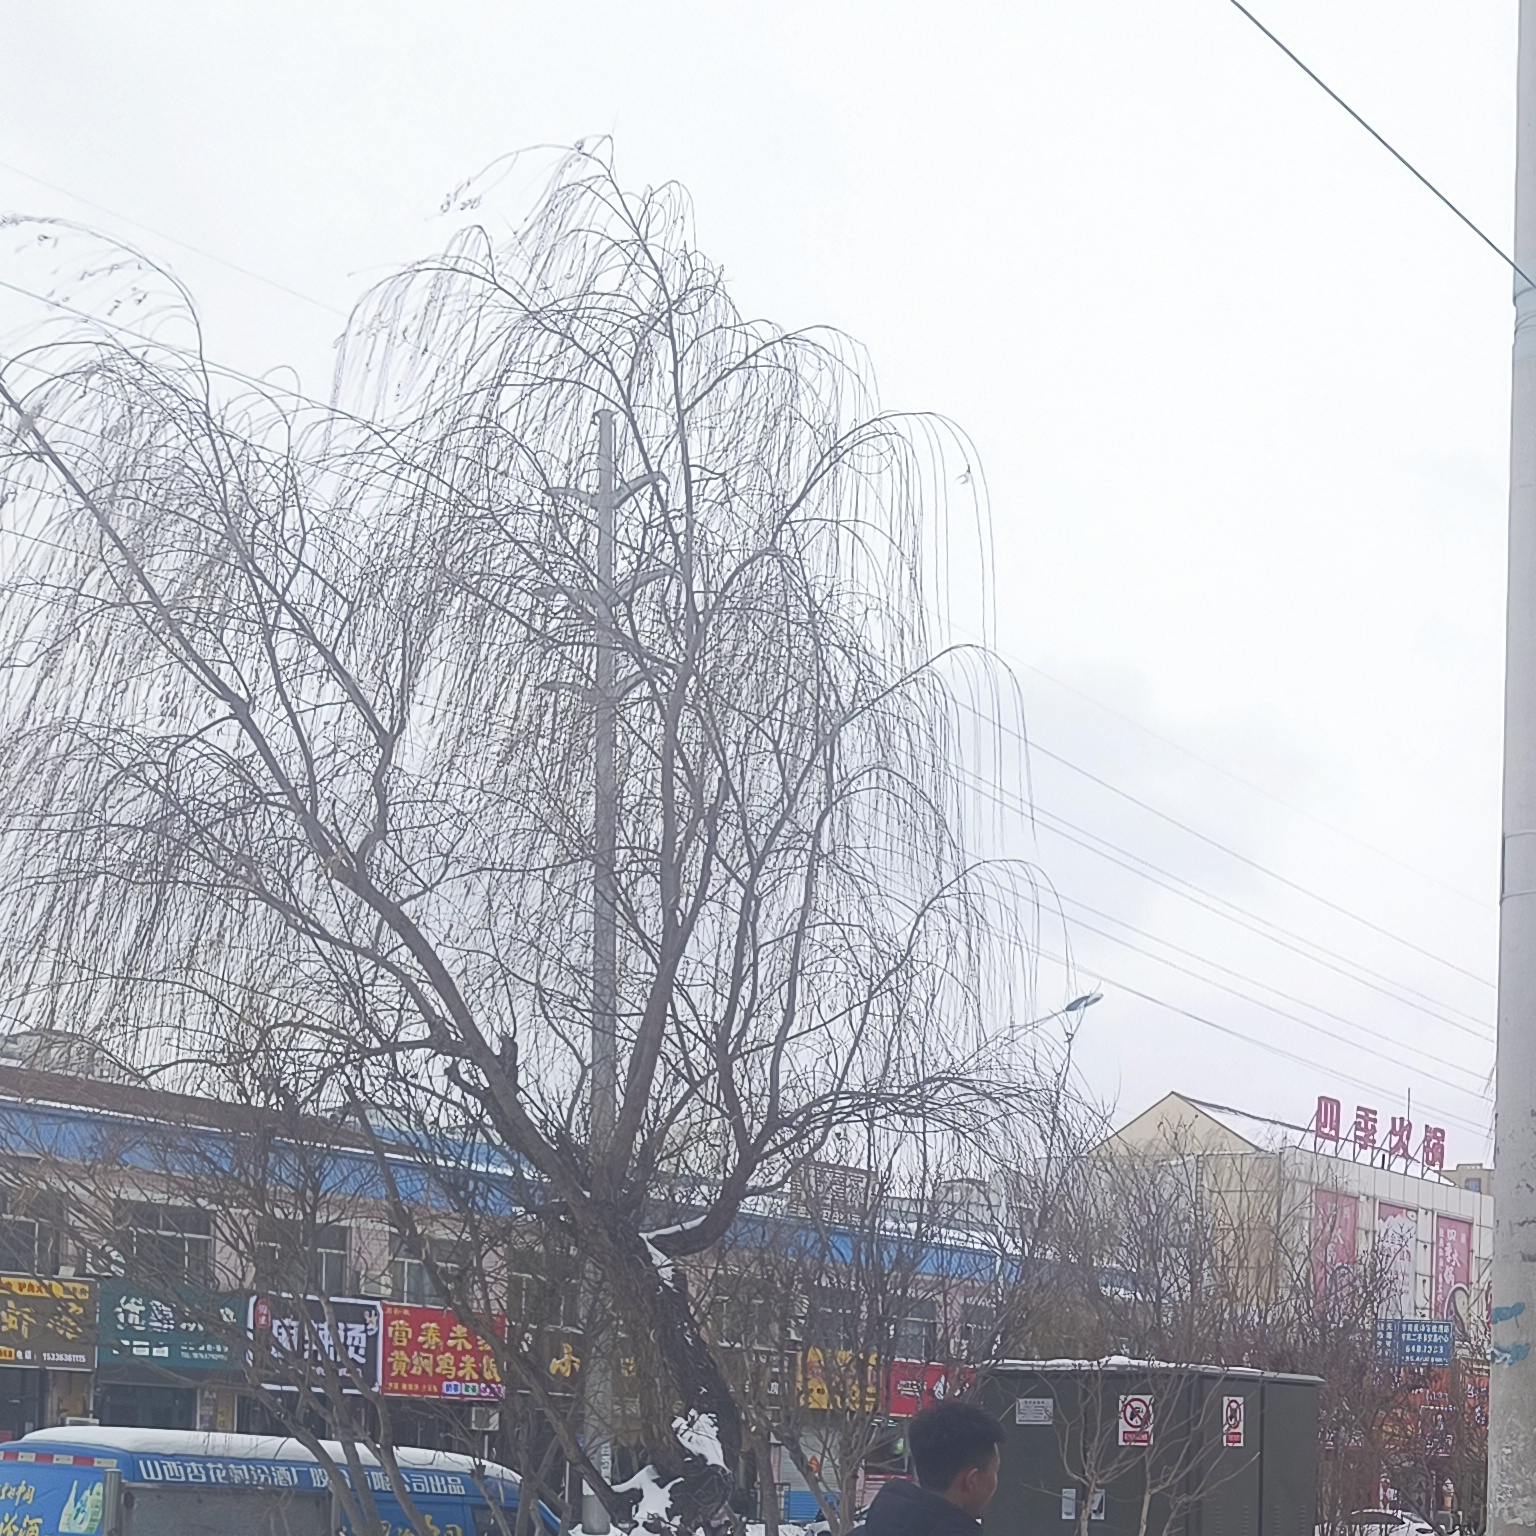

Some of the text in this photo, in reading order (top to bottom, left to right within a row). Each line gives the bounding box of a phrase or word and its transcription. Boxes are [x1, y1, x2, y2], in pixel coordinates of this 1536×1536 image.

[1317, 1096, 1446, 1169] 四季火锅
[387, 1349, 502, 1383] 黄焖鸡米饭
